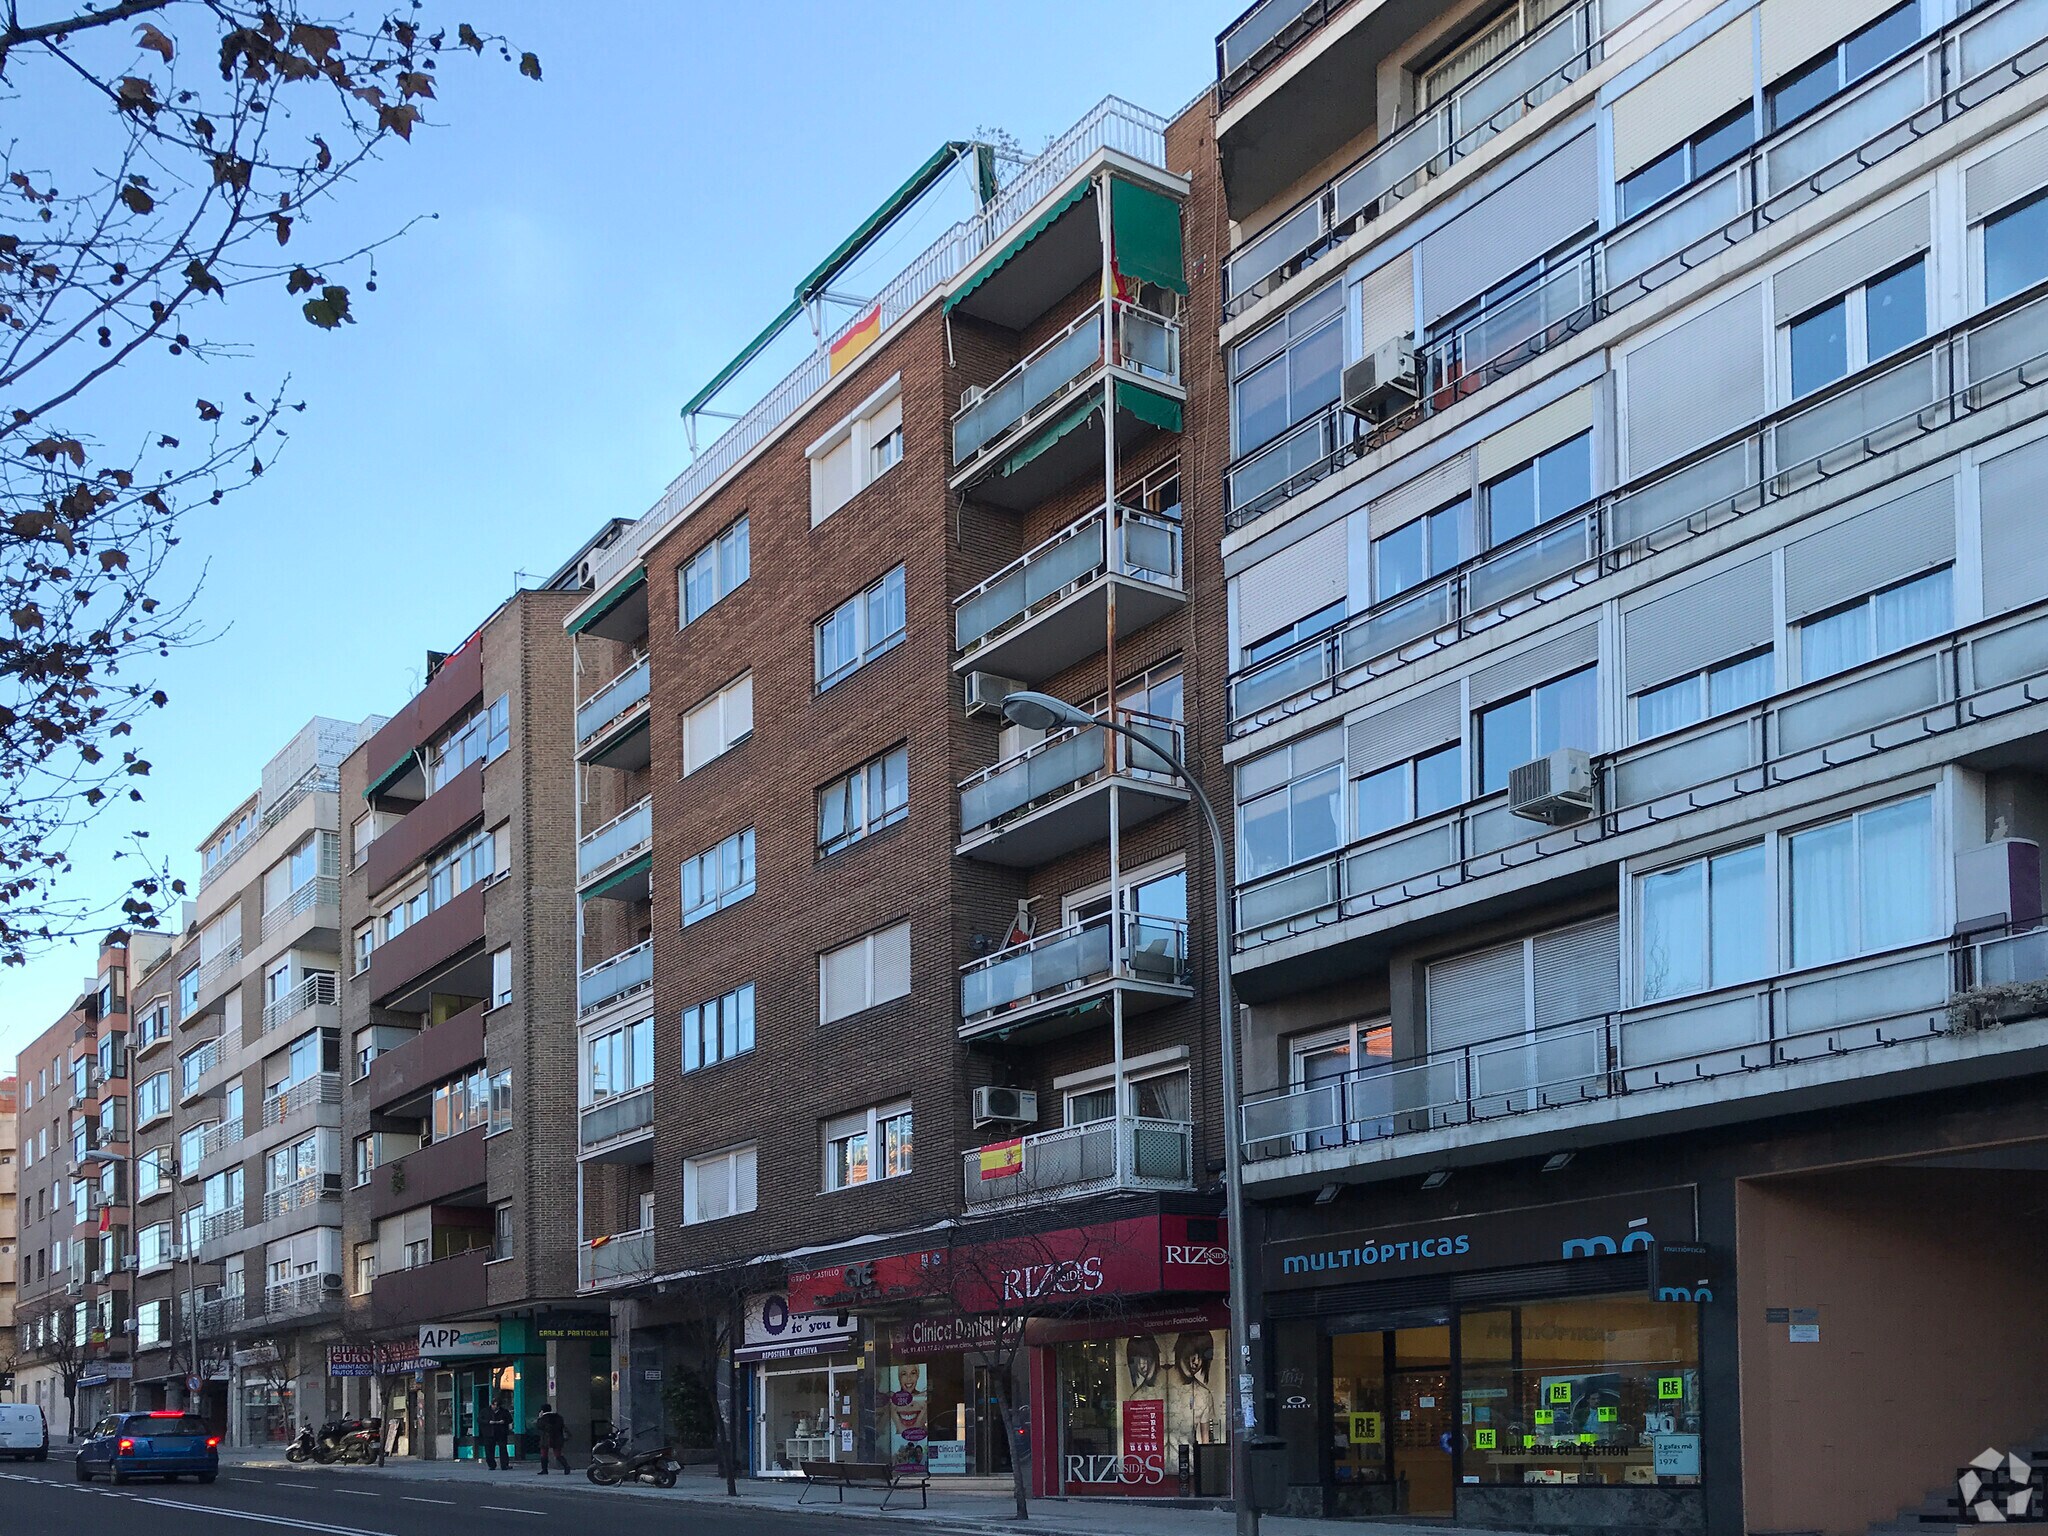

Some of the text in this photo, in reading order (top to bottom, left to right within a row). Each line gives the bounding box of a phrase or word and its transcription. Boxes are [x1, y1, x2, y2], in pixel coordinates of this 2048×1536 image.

[1165, 1245, 1230, 1266] RIZO
[1001, 1257, 1104, 1301] RIZOS
[791, 1321, 831, 1334] to you
[912, 1319, 952, 1343] Clínica
[421, 1329, 460, 1348] APP
[761, 1346, 818, 1359] REPOSTERÍA CREATIVA
[1502, 1445, 1630, 1457] NEW SUN COLLECTION
[1065, 1454, 1164, 1485] RIZOS
[1112, 1463, 1147, 1474] INSIDE
